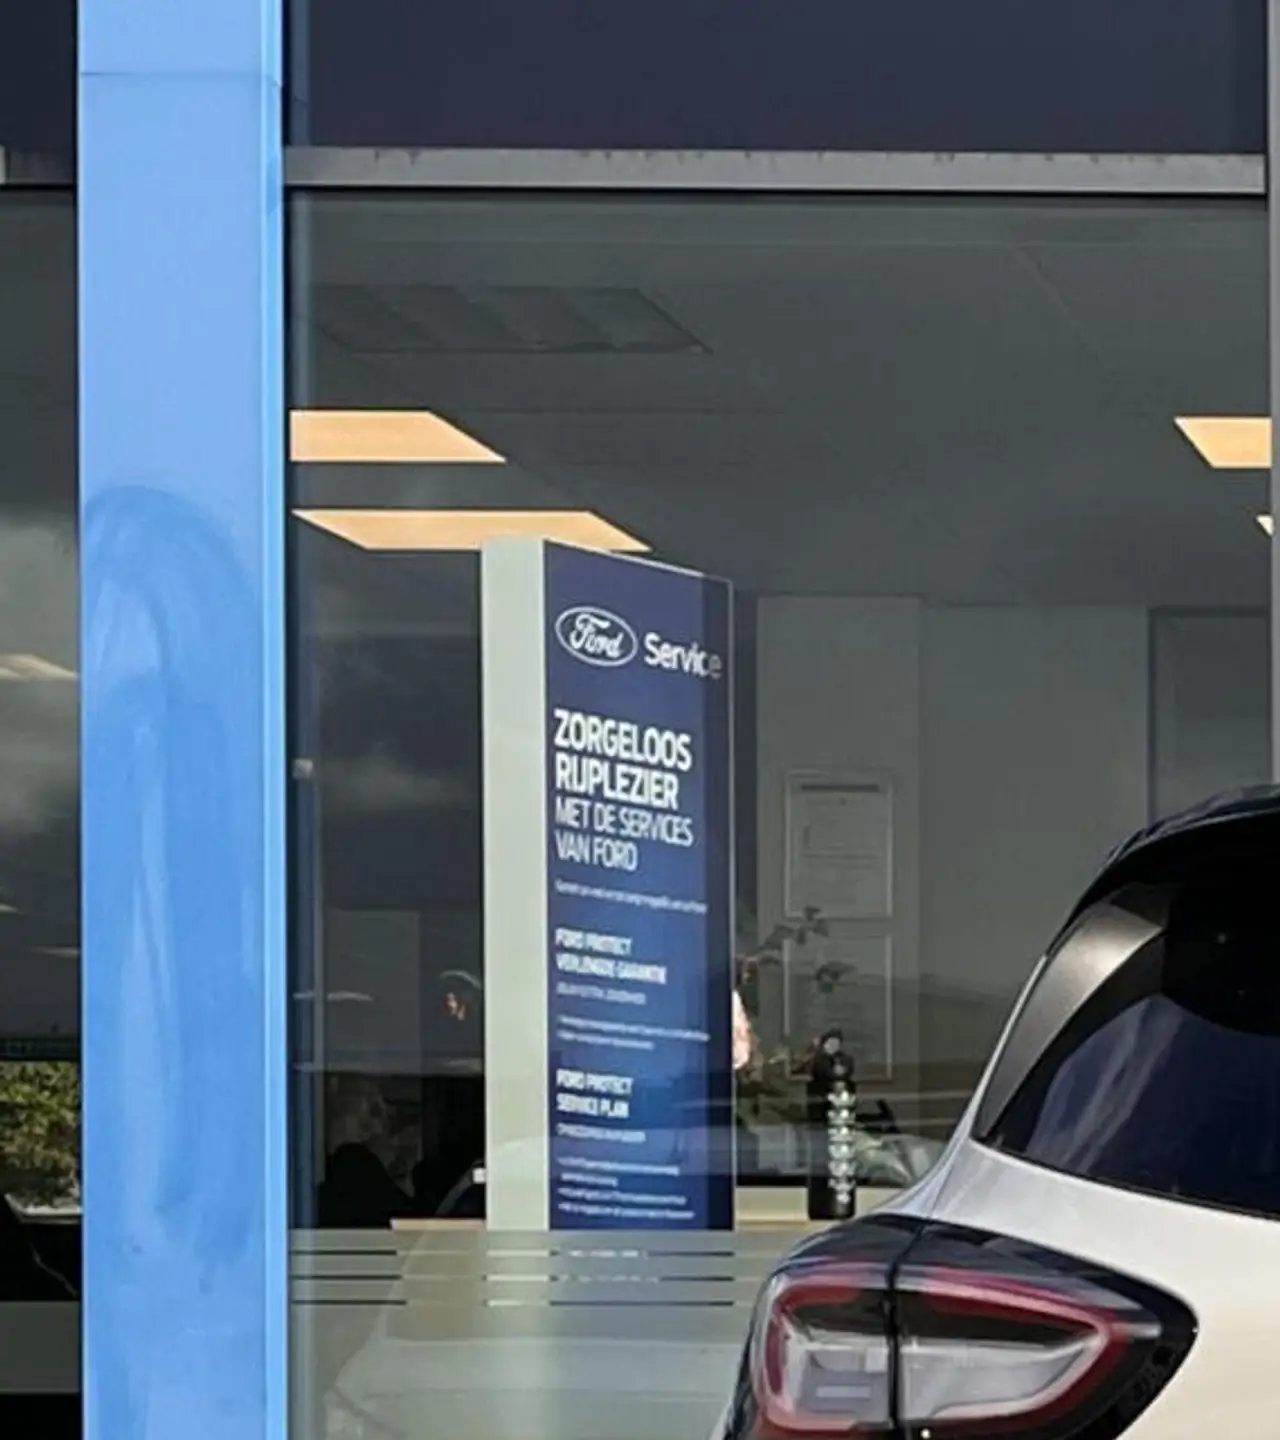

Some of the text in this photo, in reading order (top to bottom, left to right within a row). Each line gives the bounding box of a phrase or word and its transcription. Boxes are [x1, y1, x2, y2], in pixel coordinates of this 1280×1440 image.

[567, 611, 724, 680] Ford Service
[553, 708, 693, 772] ZORGELOOS
[554, 796, 693, 847] MET DE SERVICES
[554, 829, 638, 871] VAN FORD
